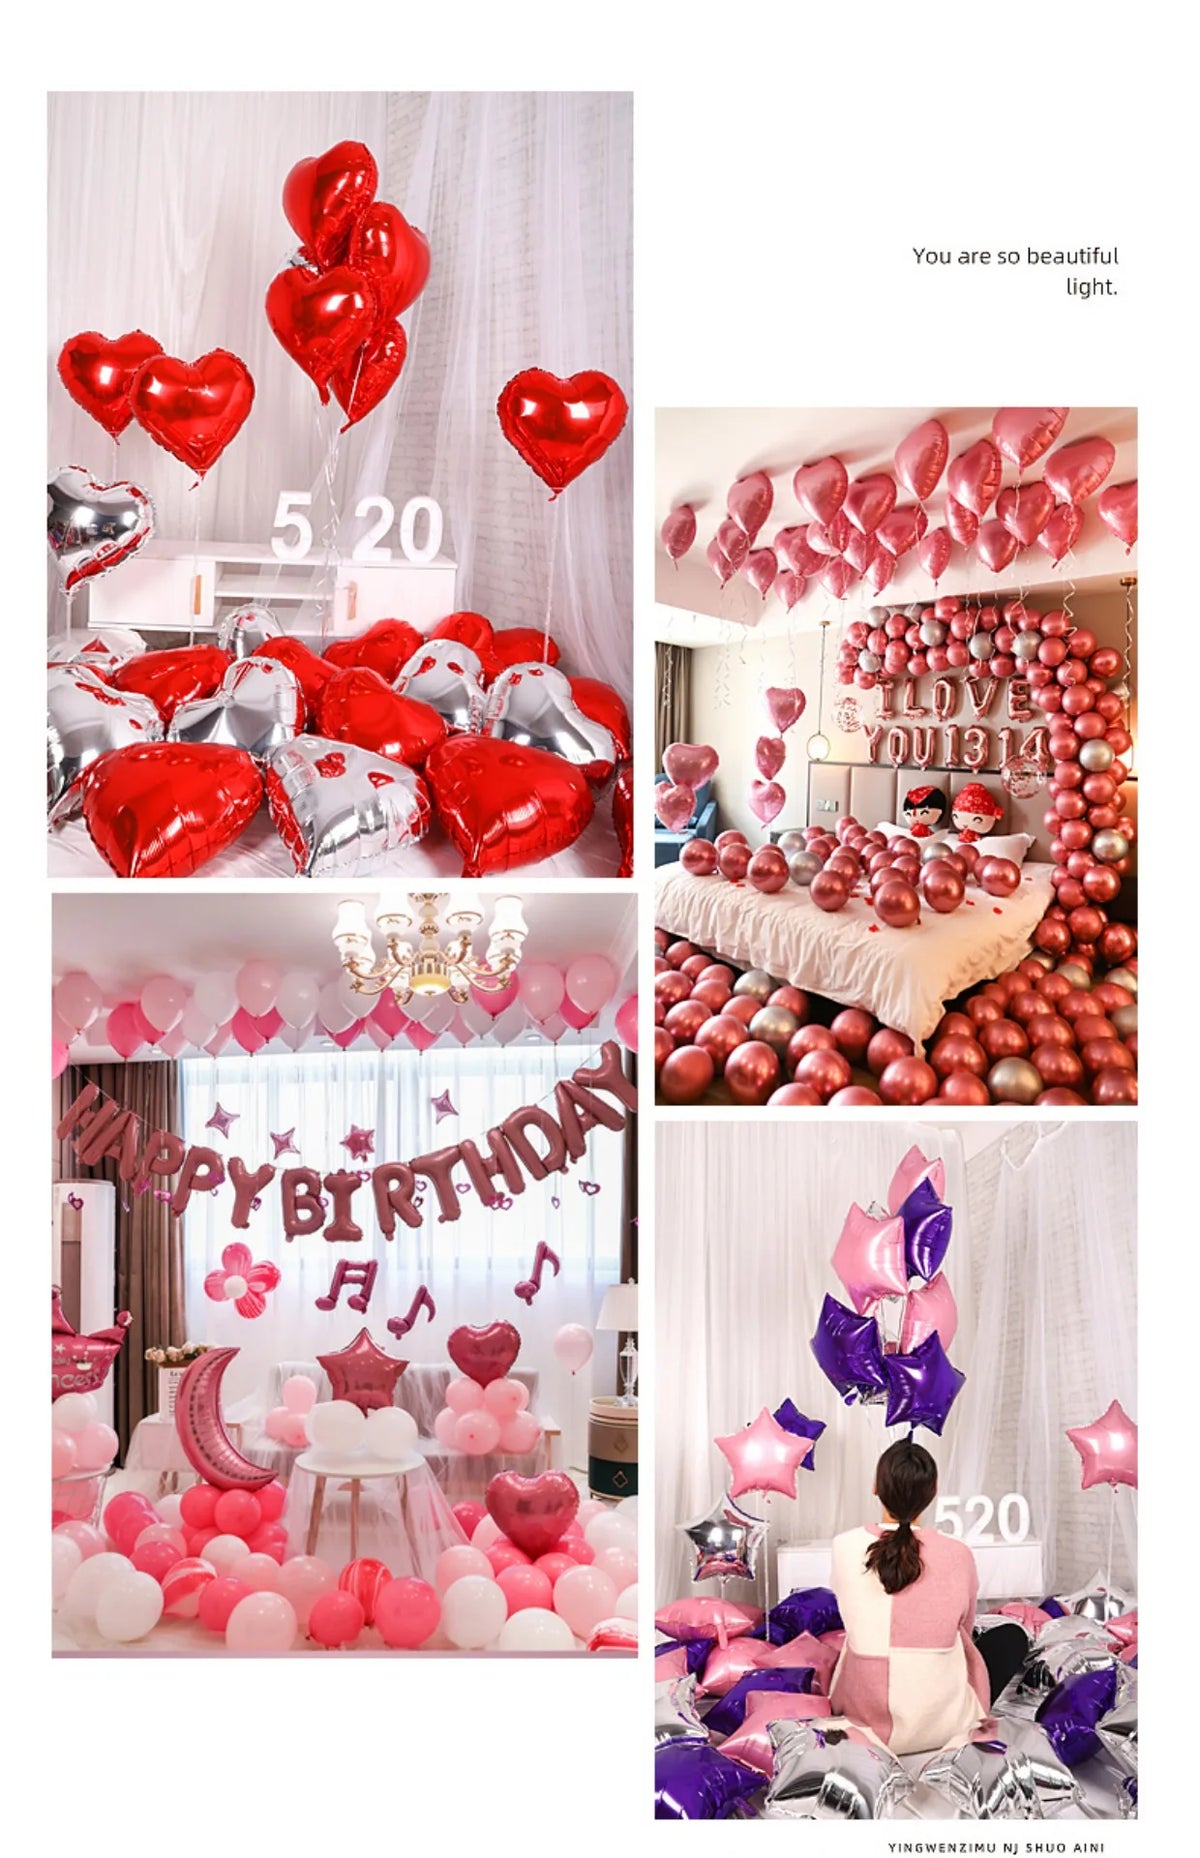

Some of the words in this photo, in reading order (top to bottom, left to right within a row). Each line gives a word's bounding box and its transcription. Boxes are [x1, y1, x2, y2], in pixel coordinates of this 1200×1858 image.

[56, 1082, 275, 1230] HAPPY
[280, 1039, 638, 1242] BIRTHDAY
[935, 1493, 1031, 1544] 520
